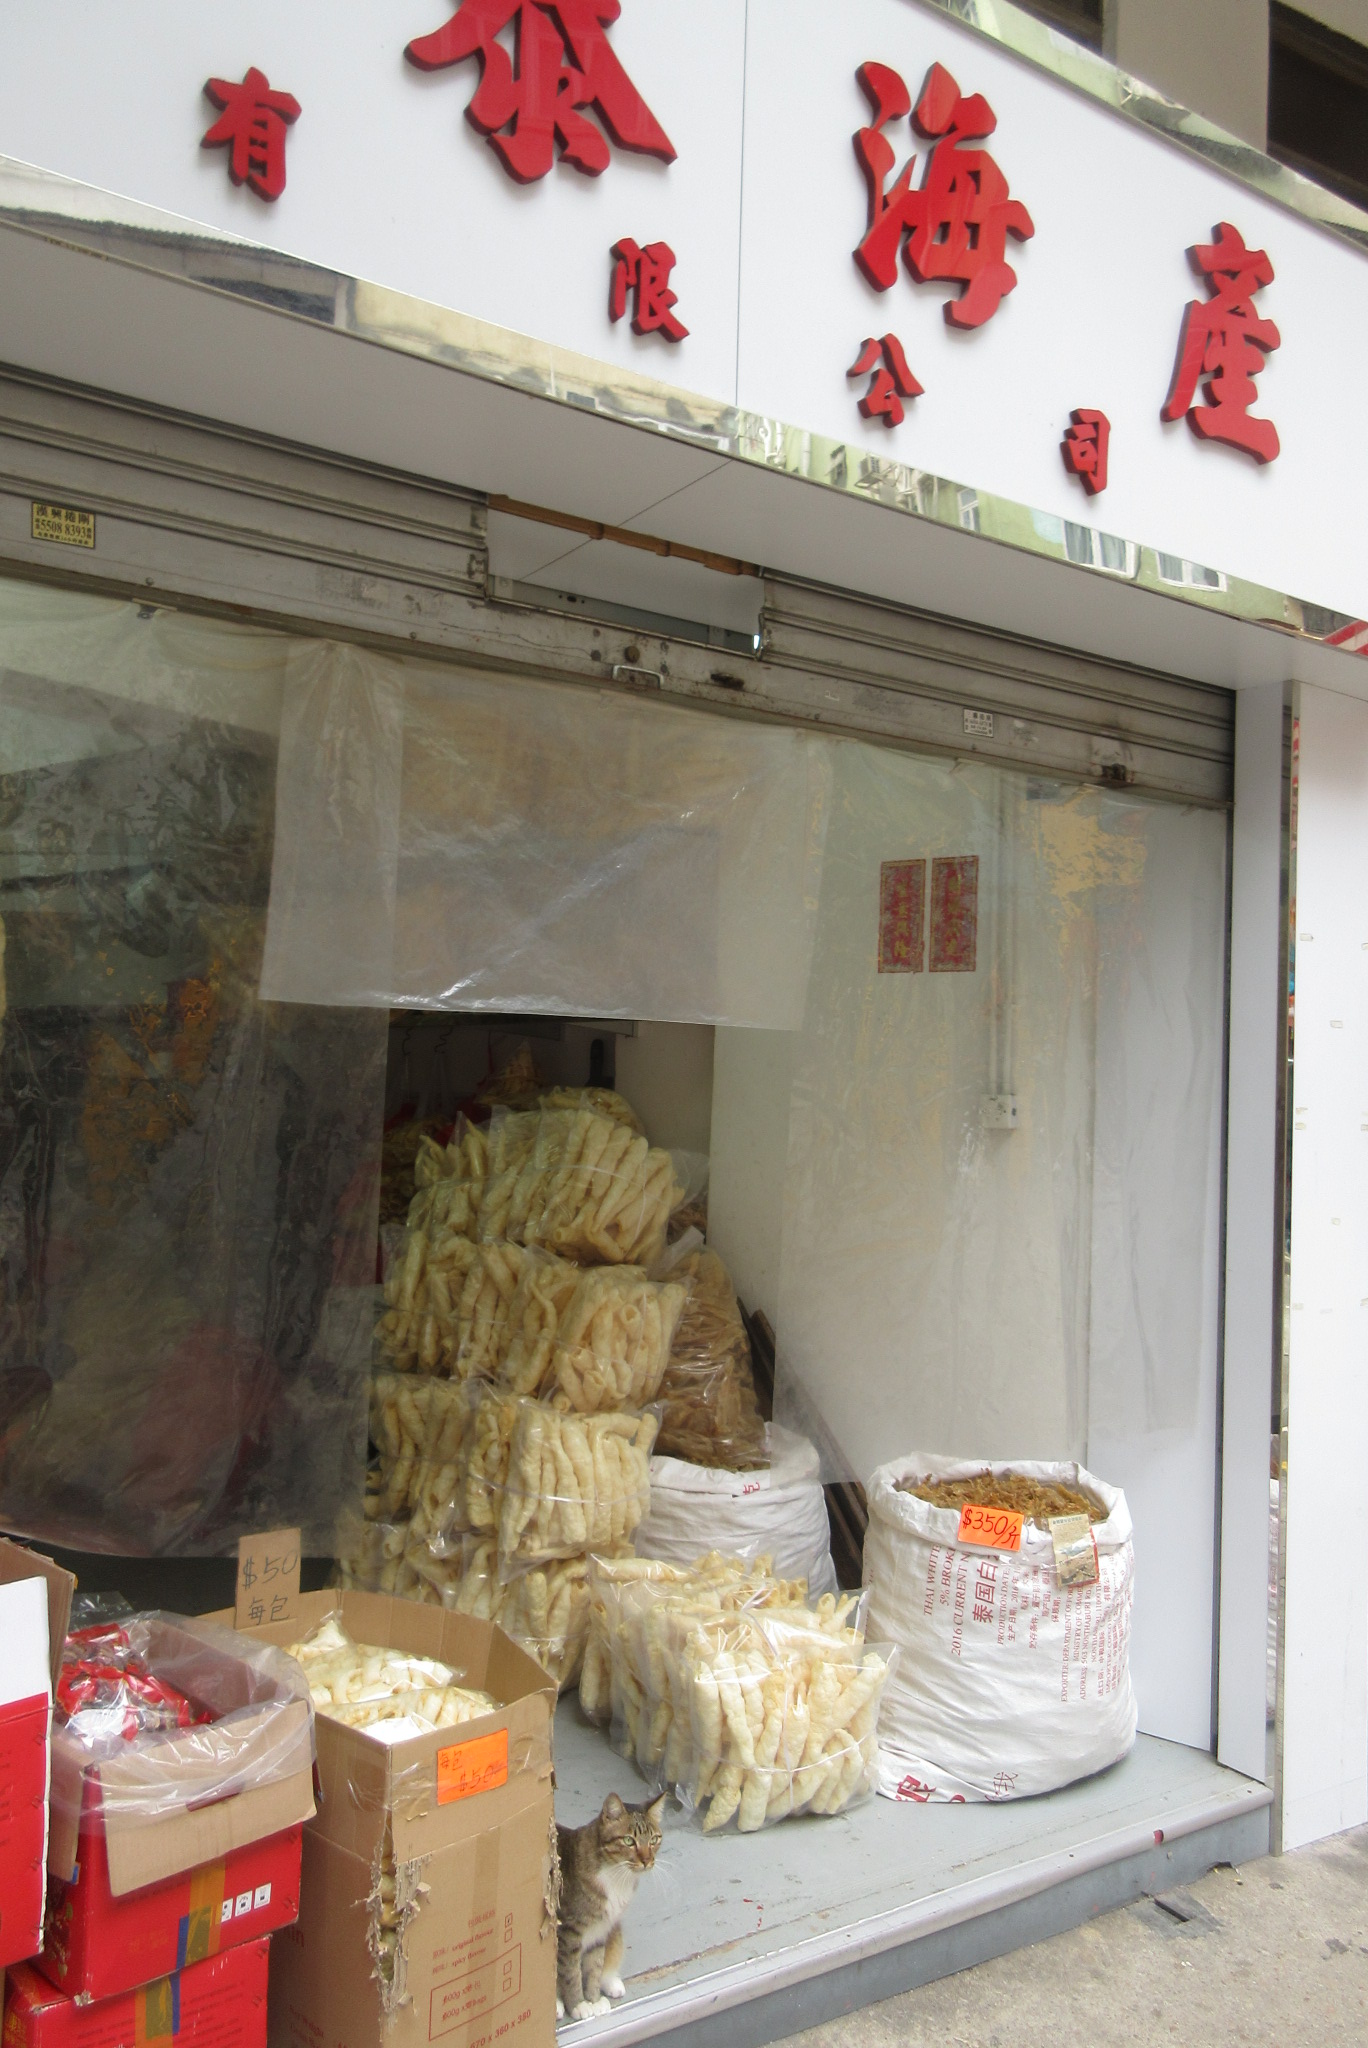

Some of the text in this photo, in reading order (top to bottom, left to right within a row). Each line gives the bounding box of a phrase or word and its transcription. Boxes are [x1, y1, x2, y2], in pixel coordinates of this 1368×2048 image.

[242, 1550, 298, 1590] $50
[924, 1544, 941, 1616] THAI WHITE
[972, 1554, 999, 1624] 泰国白
[248, 1594, 290, 1626] 每包
[940, 1589, 951, 1606] 5%
[953, 1564, 968, 1626] CURRENT
[997, 1593, 1008, 1645] PRODUCTION
[1062, 1613, 1073, 1661] DEPARTMENT
[951, 1627, 963, 1656] 2016
[1073, 1627, 1082, 1662] MINISTRY
